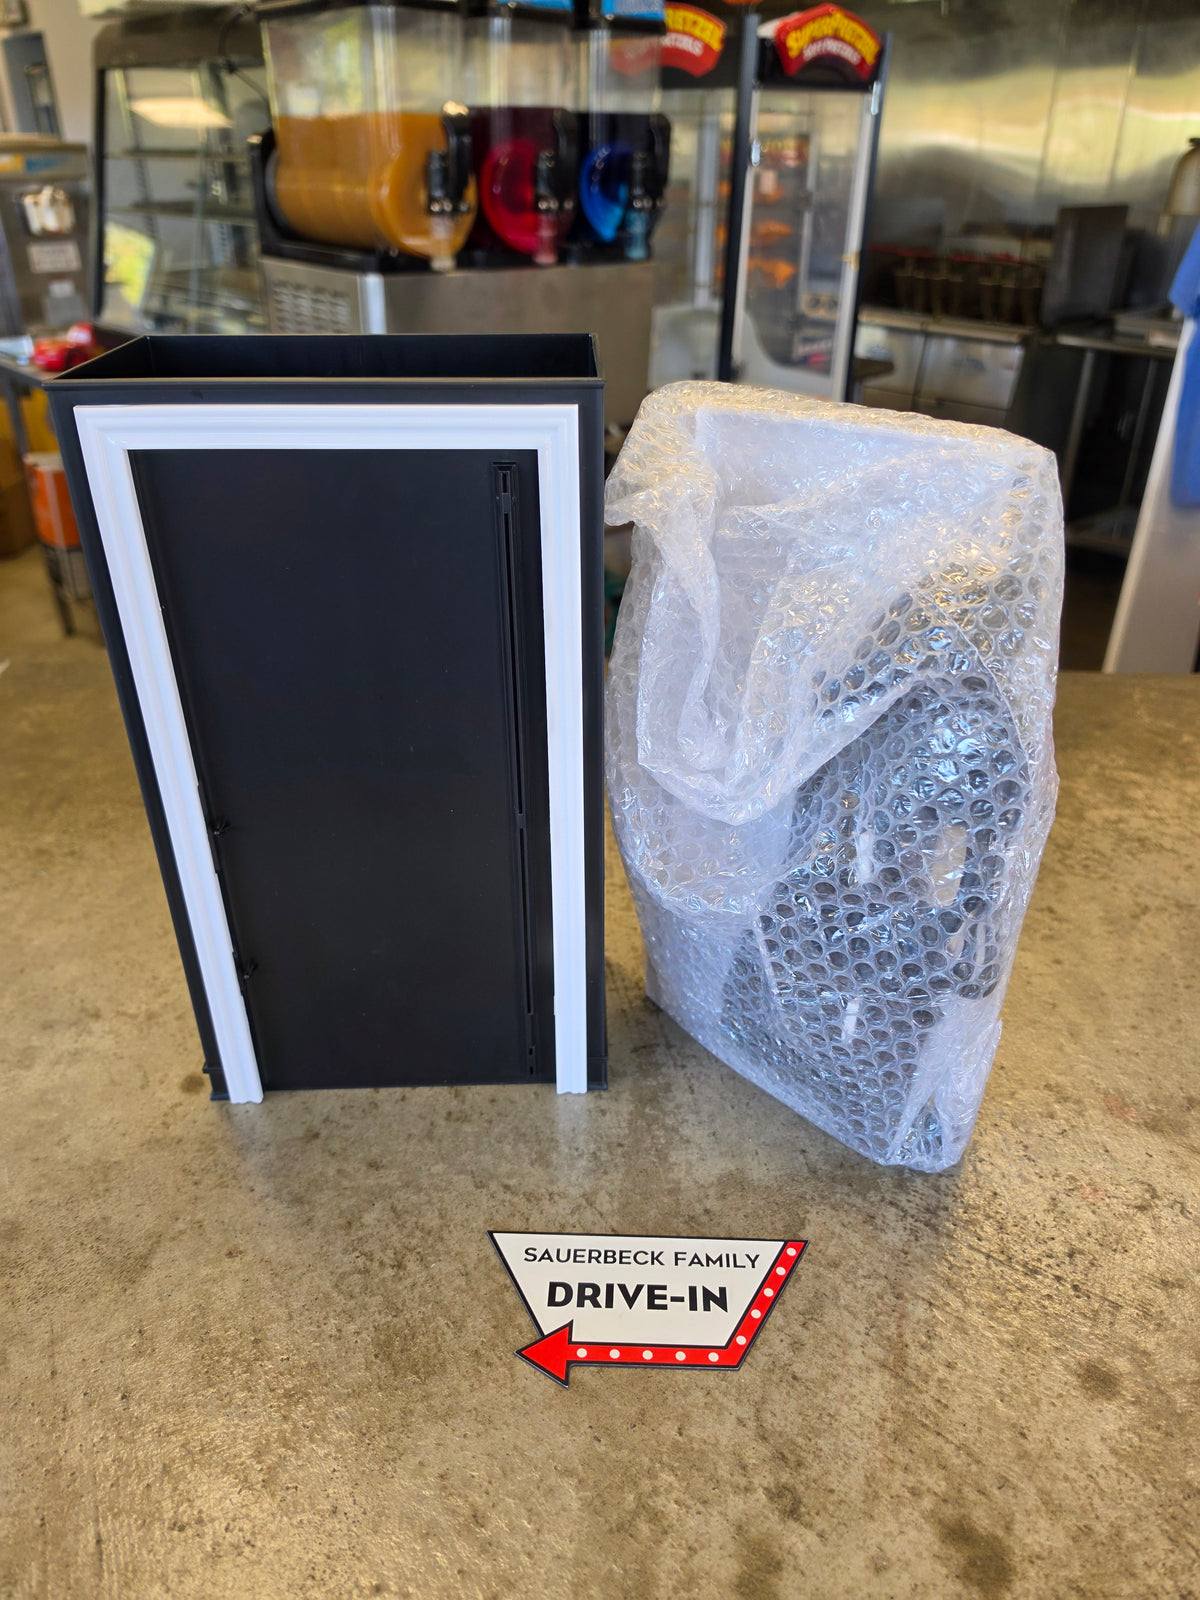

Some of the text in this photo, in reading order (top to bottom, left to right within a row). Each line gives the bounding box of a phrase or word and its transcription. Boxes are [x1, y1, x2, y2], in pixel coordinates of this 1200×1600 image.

[523, 1247, 760, 1269] SAUERBECK FAMILY
[547, 1281, 728, 1313] DRIVE-IN
